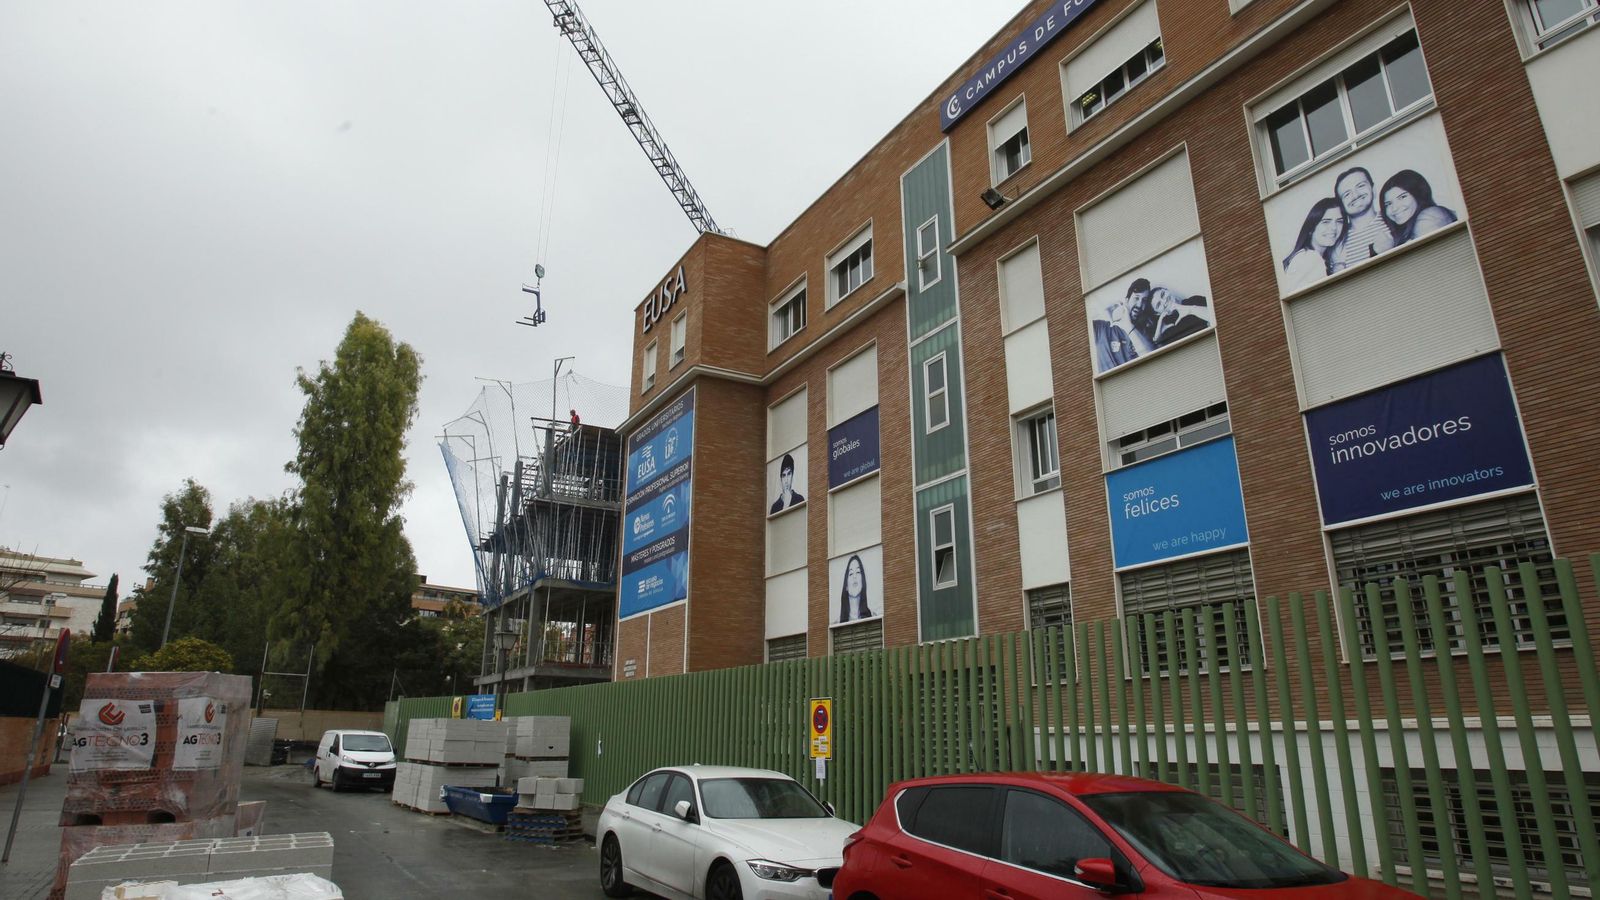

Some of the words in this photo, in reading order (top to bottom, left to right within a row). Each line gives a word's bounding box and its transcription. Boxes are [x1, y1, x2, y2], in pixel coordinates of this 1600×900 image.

[966, 41, 1028, 100] CAMPUS
[1035, 15, 1056, 42] DE
[643, 265, 686, 334] EUSA
[833, 438, 848, 449] somos
[1329, 424, 1377, 446] somos
[1330, 415, 1472, 465] innovadores
[832, 440, 860, 460] globales
[637, 456, 656, 478] EUSA
[860, 458, 875, 472] global
[1123, 485, 1155, 502] somos
[1380, 487, 1400, 501] we
[1403, 481, 1425, 496] are
[1428, 465, 1505, 492] innovators
[1124, 494, 1180, 520] felices
[1152, 541, 1169, 552] we
[1171, 536, 1189, 549] are
[1190, 526, 1227, 545] happy
